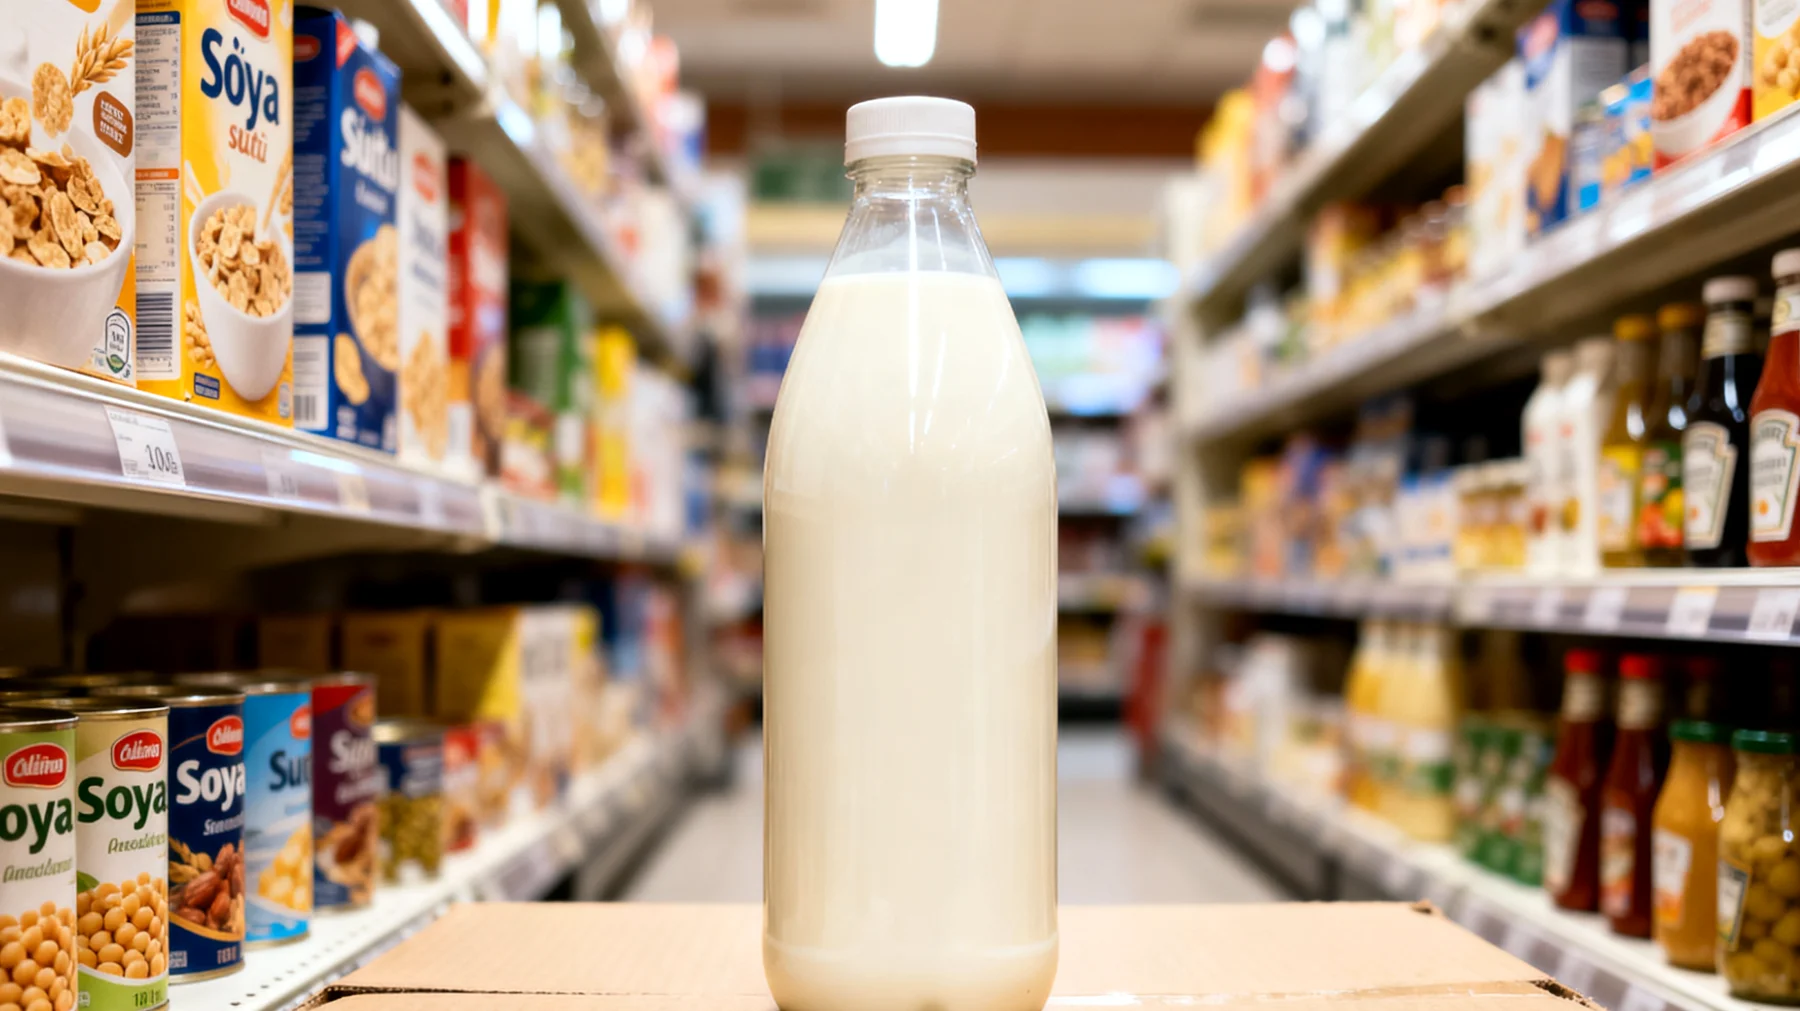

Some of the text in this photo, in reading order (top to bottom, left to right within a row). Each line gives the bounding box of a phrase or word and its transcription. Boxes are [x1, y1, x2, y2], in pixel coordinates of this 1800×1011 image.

[201, 28, 279, 131] Söya
[77, 776, 168, 830] Soya
[176, 759, 246, 812] Soya
